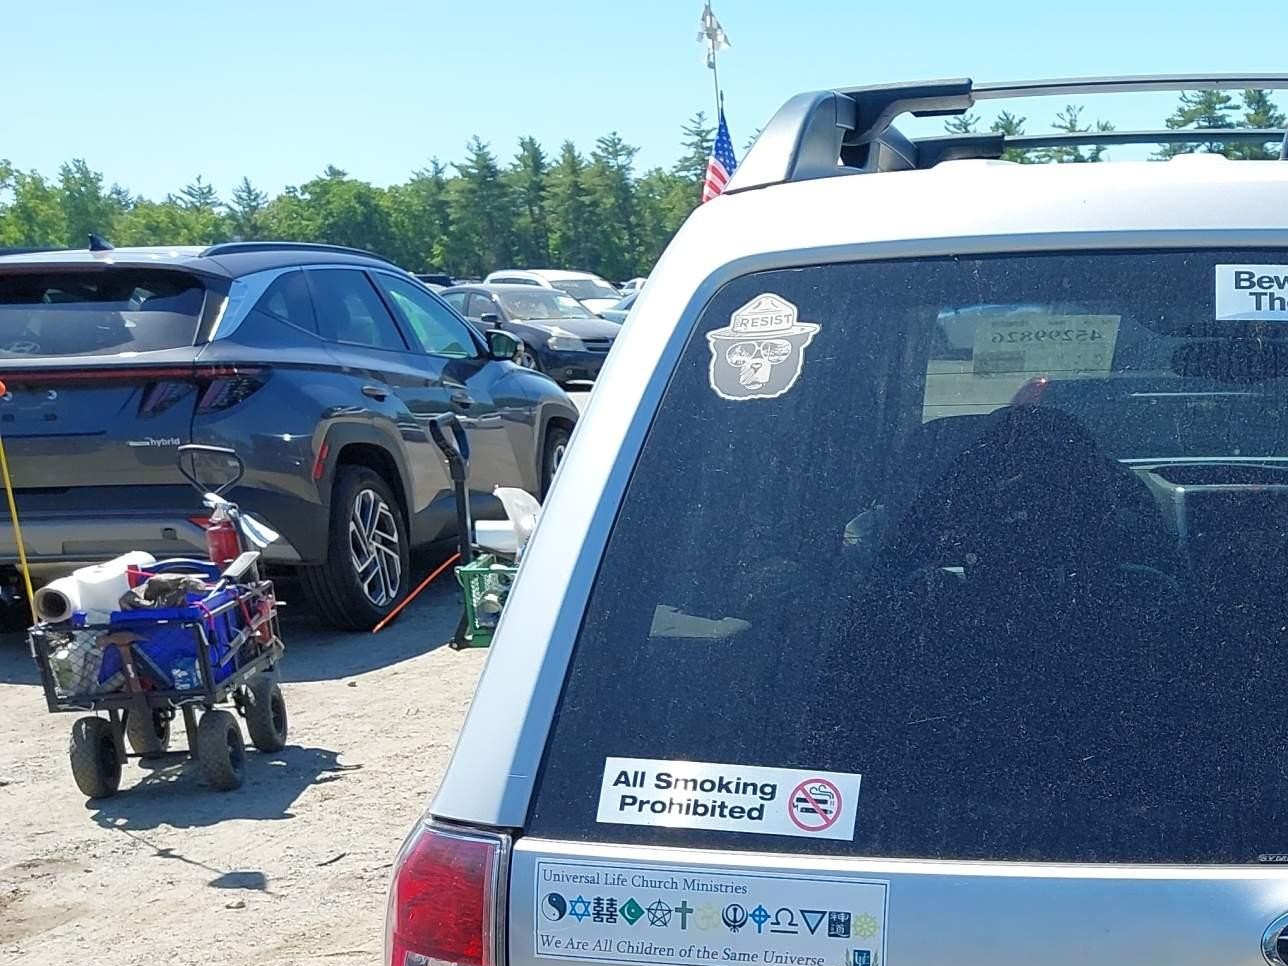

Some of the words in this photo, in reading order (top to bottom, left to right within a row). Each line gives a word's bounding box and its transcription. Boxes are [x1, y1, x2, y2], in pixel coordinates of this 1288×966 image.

[739, 313, 793, 328] RESIST
[150, 437, 181, 447] hybrid
[612, 770, 646, 788] All
[654, 771, 778, 800] Smoking
[618, 794, 766, 821] Prohibited
[542, 868, 601, 885] Universal
[604, 872, 628, 887] Life
[630, 873, 679, 890] Church
[682, 877, 748, 895] Ministries
[540, 933, 562, 949] We
[564, 936, 590, 952] Are
[591, 938, 613, 953] All
[616, 940, 675, 958] Children
[678, 944, 694, 959] of
[696, 945, 719, 961] the
[722, 948, 758, 964] Same
